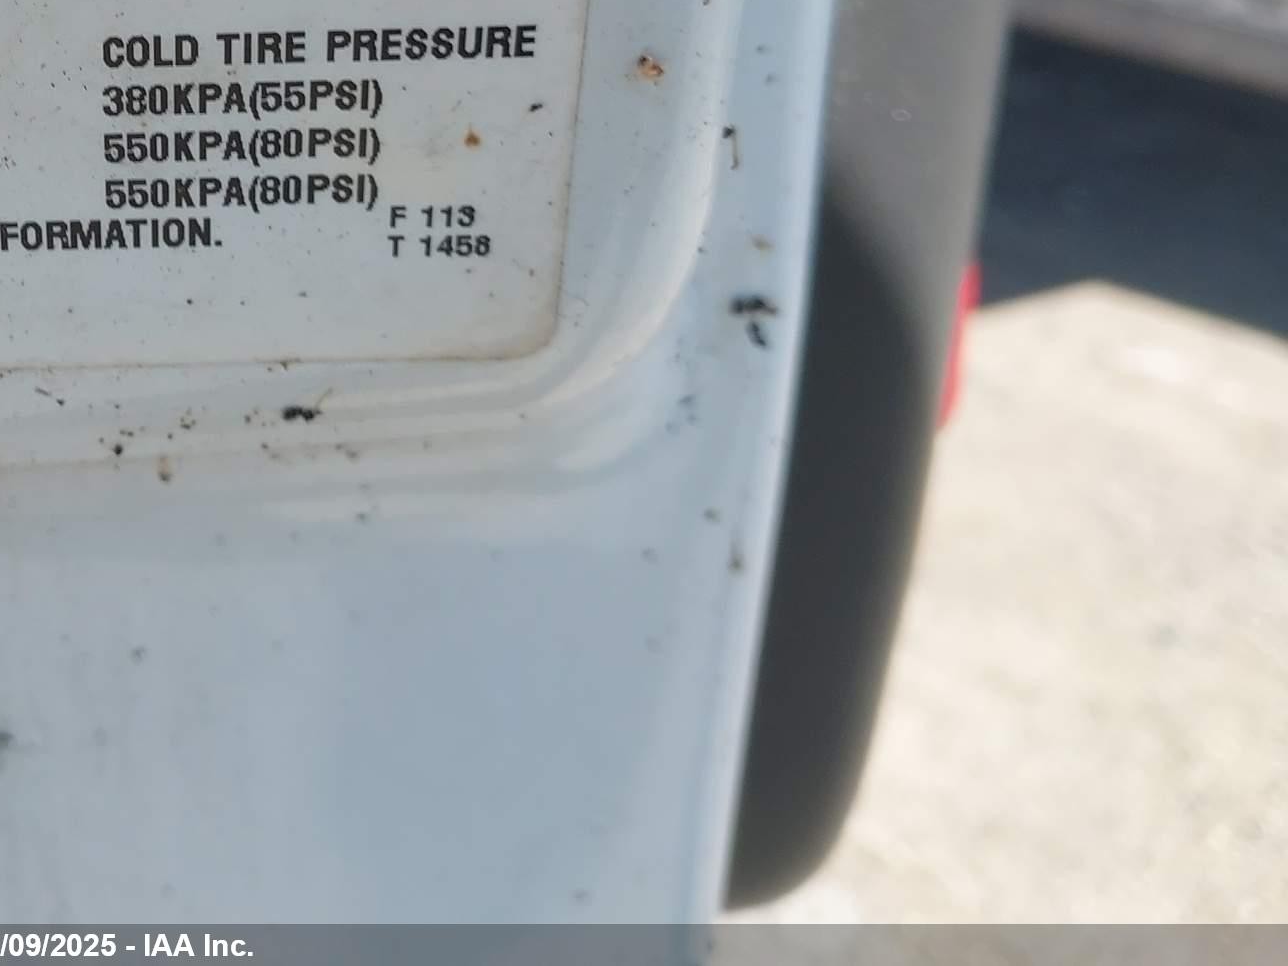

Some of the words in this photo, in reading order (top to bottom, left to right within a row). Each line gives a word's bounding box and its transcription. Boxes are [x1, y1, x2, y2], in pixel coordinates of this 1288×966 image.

[103, 35, 198, 68] COLD
[216, 31, 305, 65] TIRE
[327, 25, 536, 62] PRESSURE
[103, 79, 382, 120] 380KPA(55PSI)
[104, 128, 380, 167] 550KPA(80PSI)
[106, 174, 378, 213] 550KPA(80PSI)
[390, 206, 406, 228] F
[422, 206, 475, 227] 113
[388, 236, 404, 257] T
